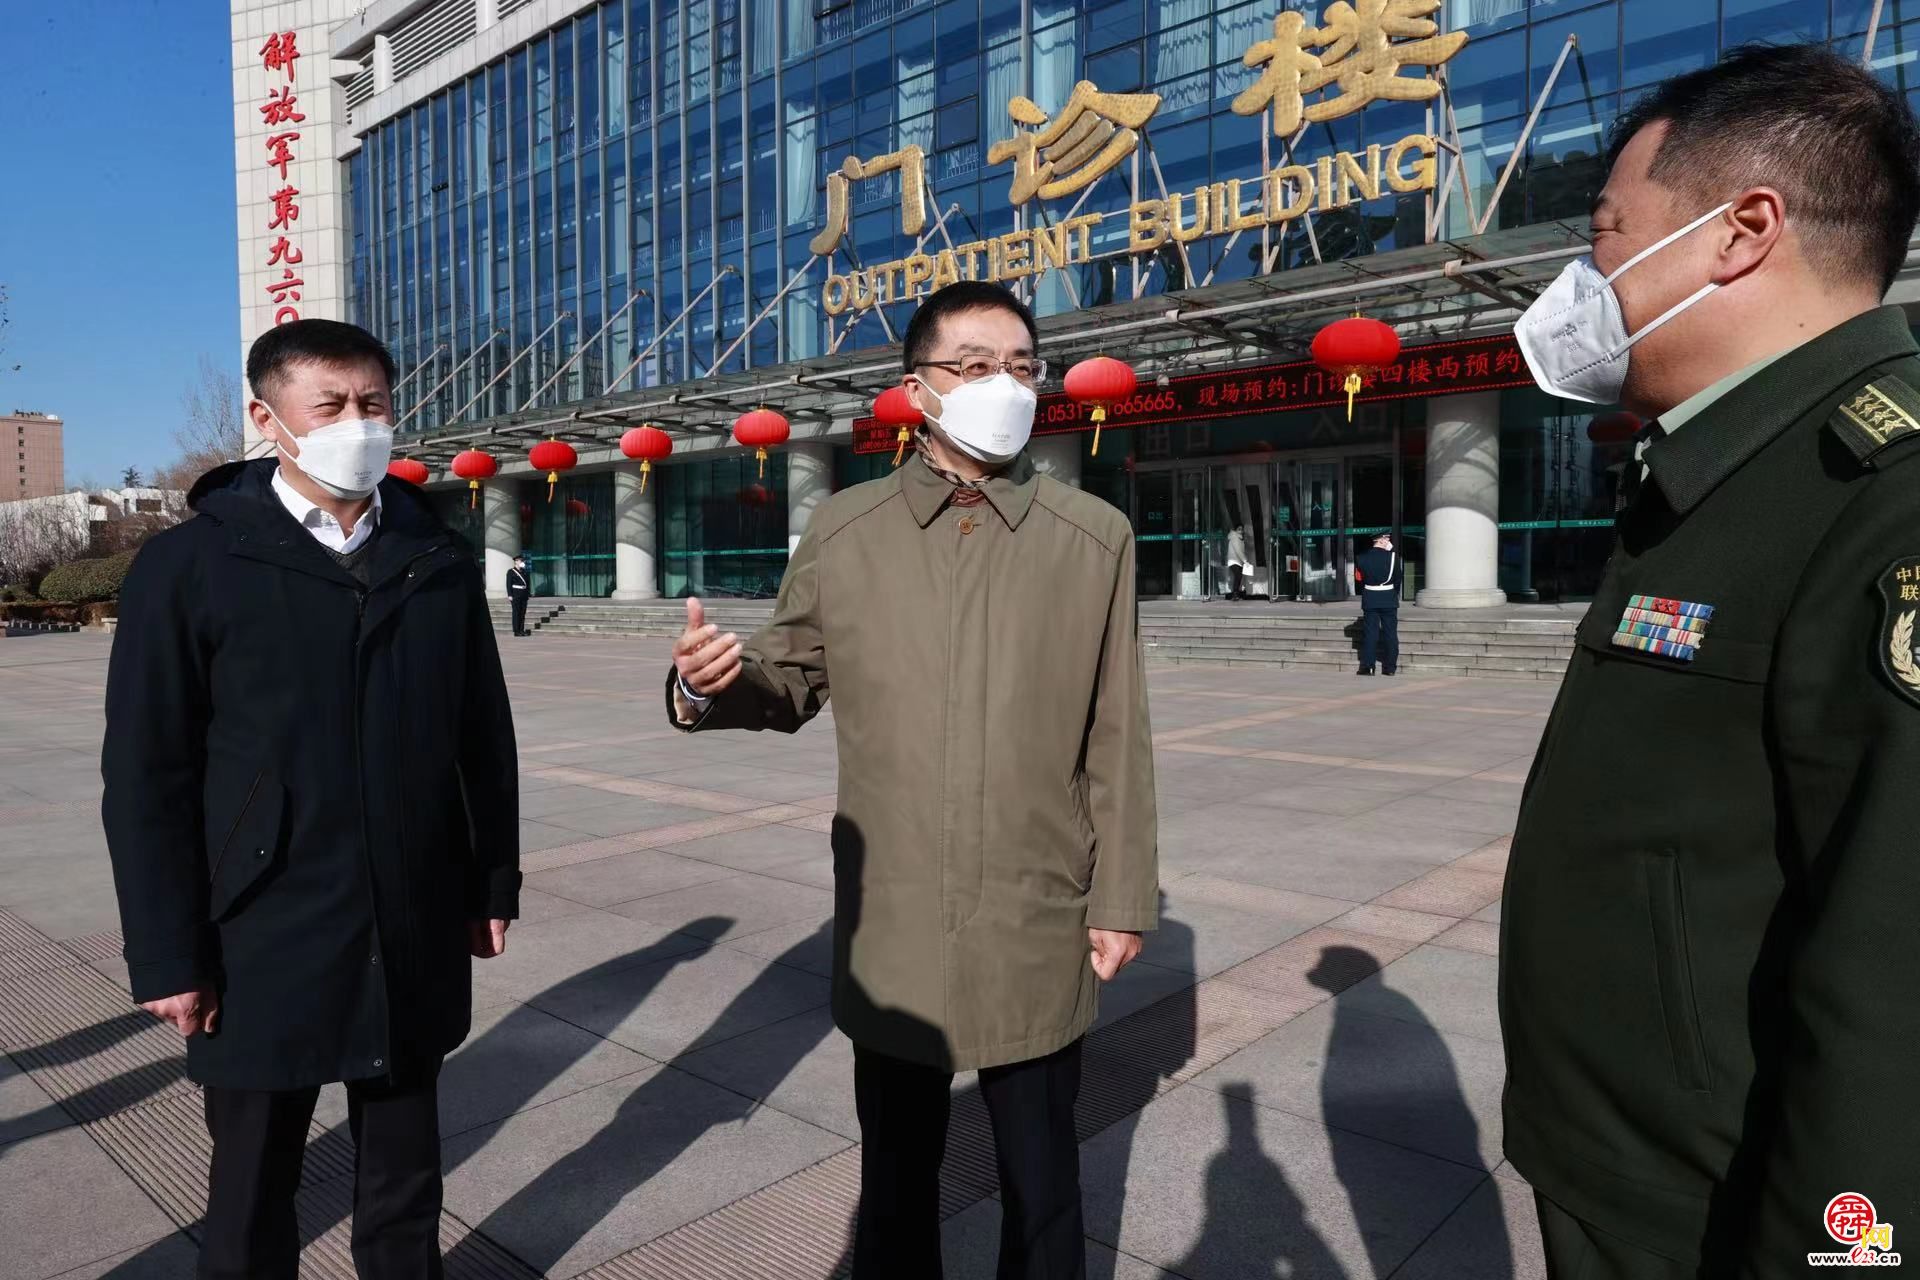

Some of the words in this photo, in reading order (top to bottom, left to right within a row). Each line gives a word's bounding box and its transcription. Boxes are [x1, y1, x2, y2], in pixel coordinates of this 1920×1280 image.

[809, 0, 1470, 255] 门诊楼
[822, 212, 1103, 316] OUTPATIENT
[1129, 133, 1437, 253] BUILDING
[1896, 565, 1920, 583] 中
